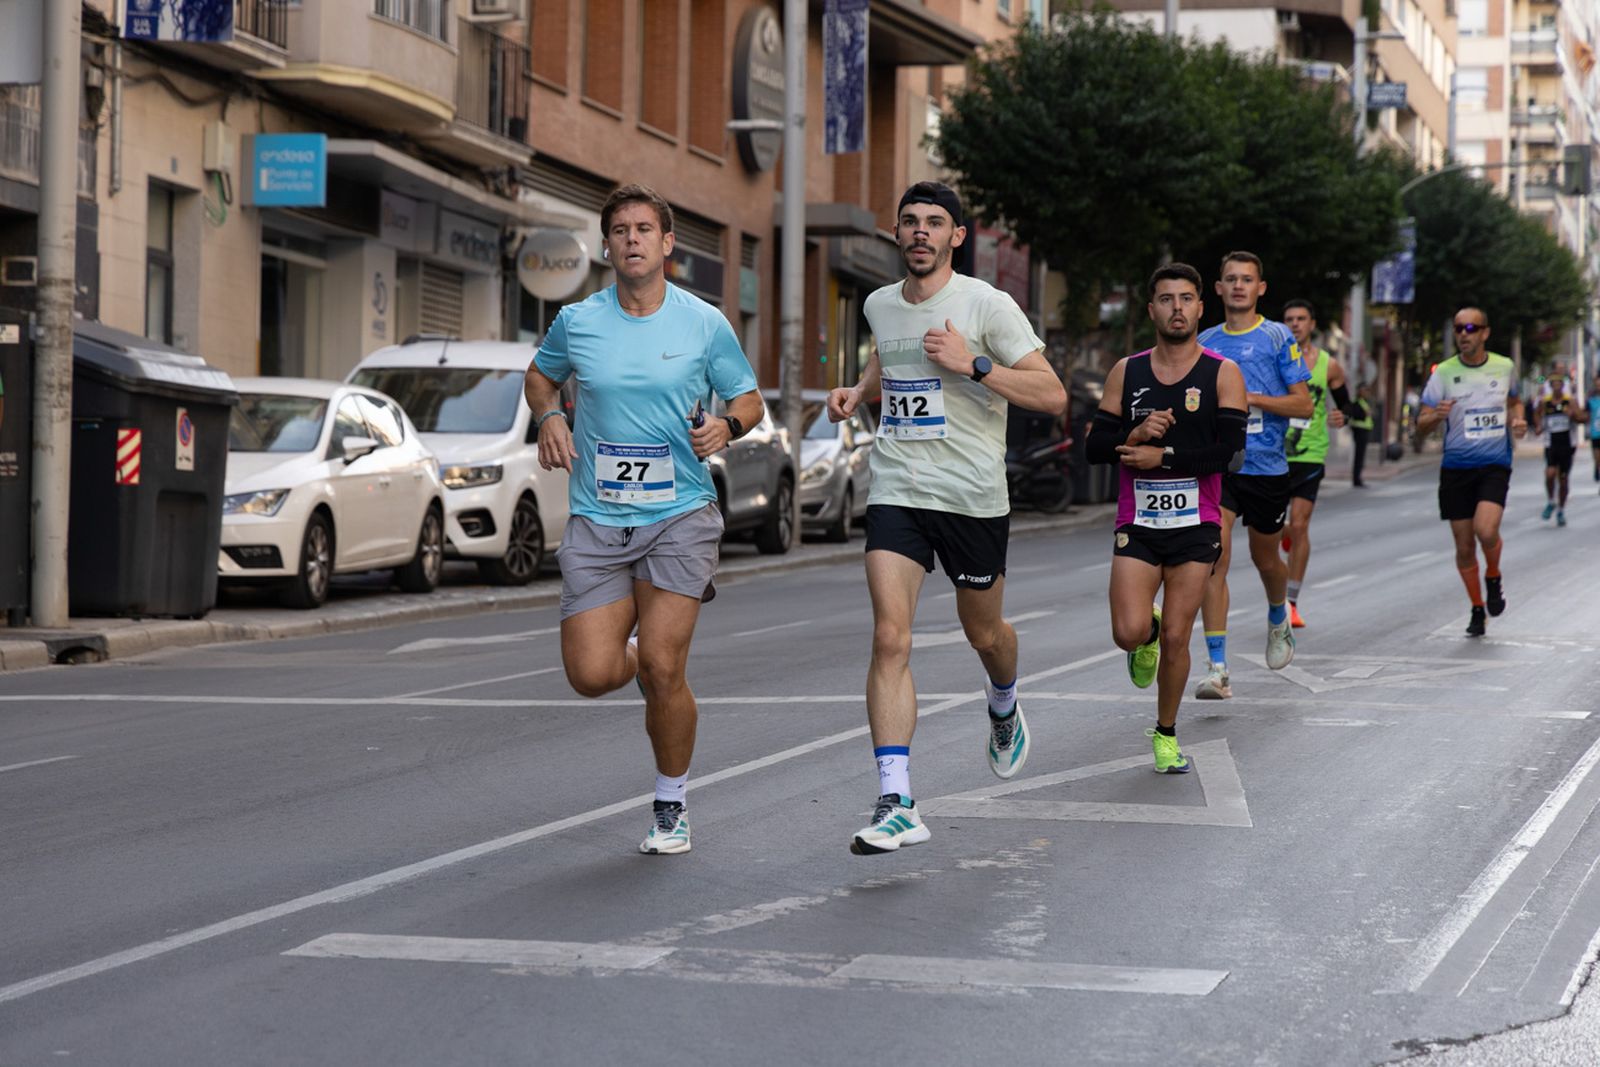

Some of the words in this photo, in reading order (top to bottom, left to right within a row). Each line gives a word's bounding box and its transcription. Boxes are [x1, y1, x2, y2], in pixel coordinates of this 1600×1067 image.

[889, 396, 929, 416] 512
[1474, 415, 1498, 426] 196
[616, 461, 650, 481] 27
[1146, 493, 1187, 510] 280
[966, 575, 992, 583] TERREX
